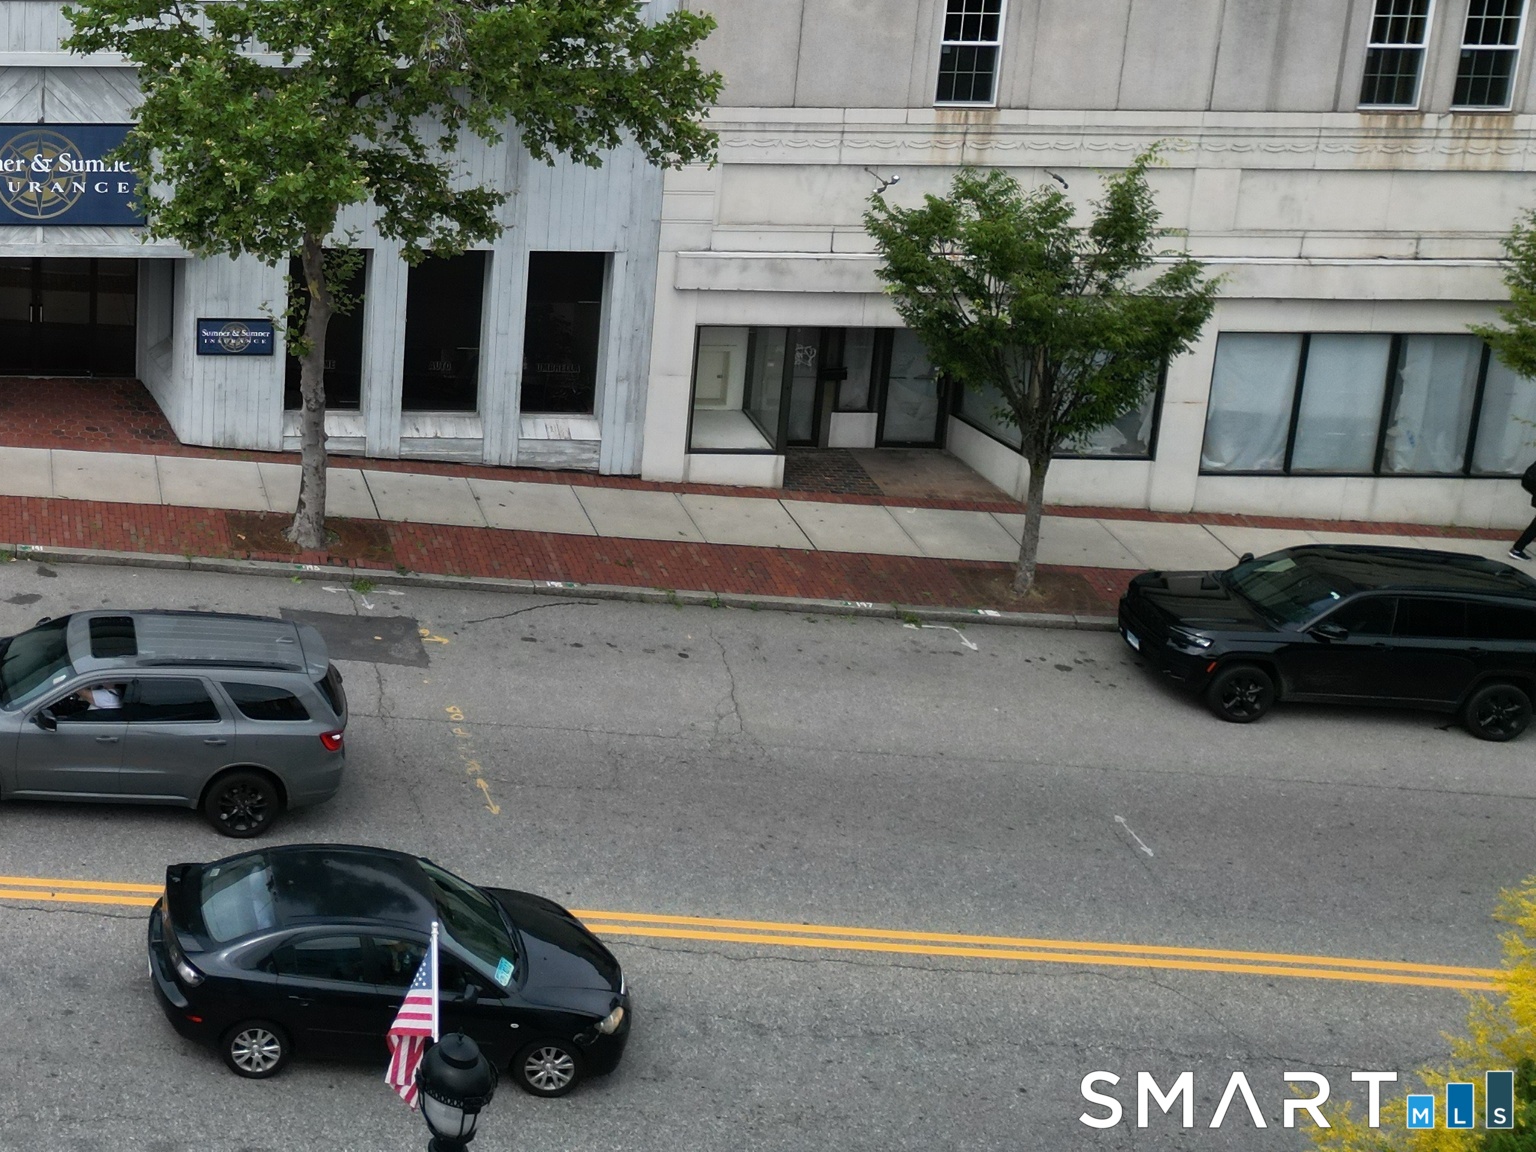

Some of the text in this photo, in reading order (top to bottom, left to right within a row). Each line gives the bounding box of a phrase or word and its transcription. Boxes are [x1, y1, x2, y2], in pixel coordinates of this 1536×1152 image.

[31, 153, 53, 172] &
[59, 153, 138, 173] Sumne
[202, 329, 230, 337] Sumner
[241, 329, 270, 337] Sumner
